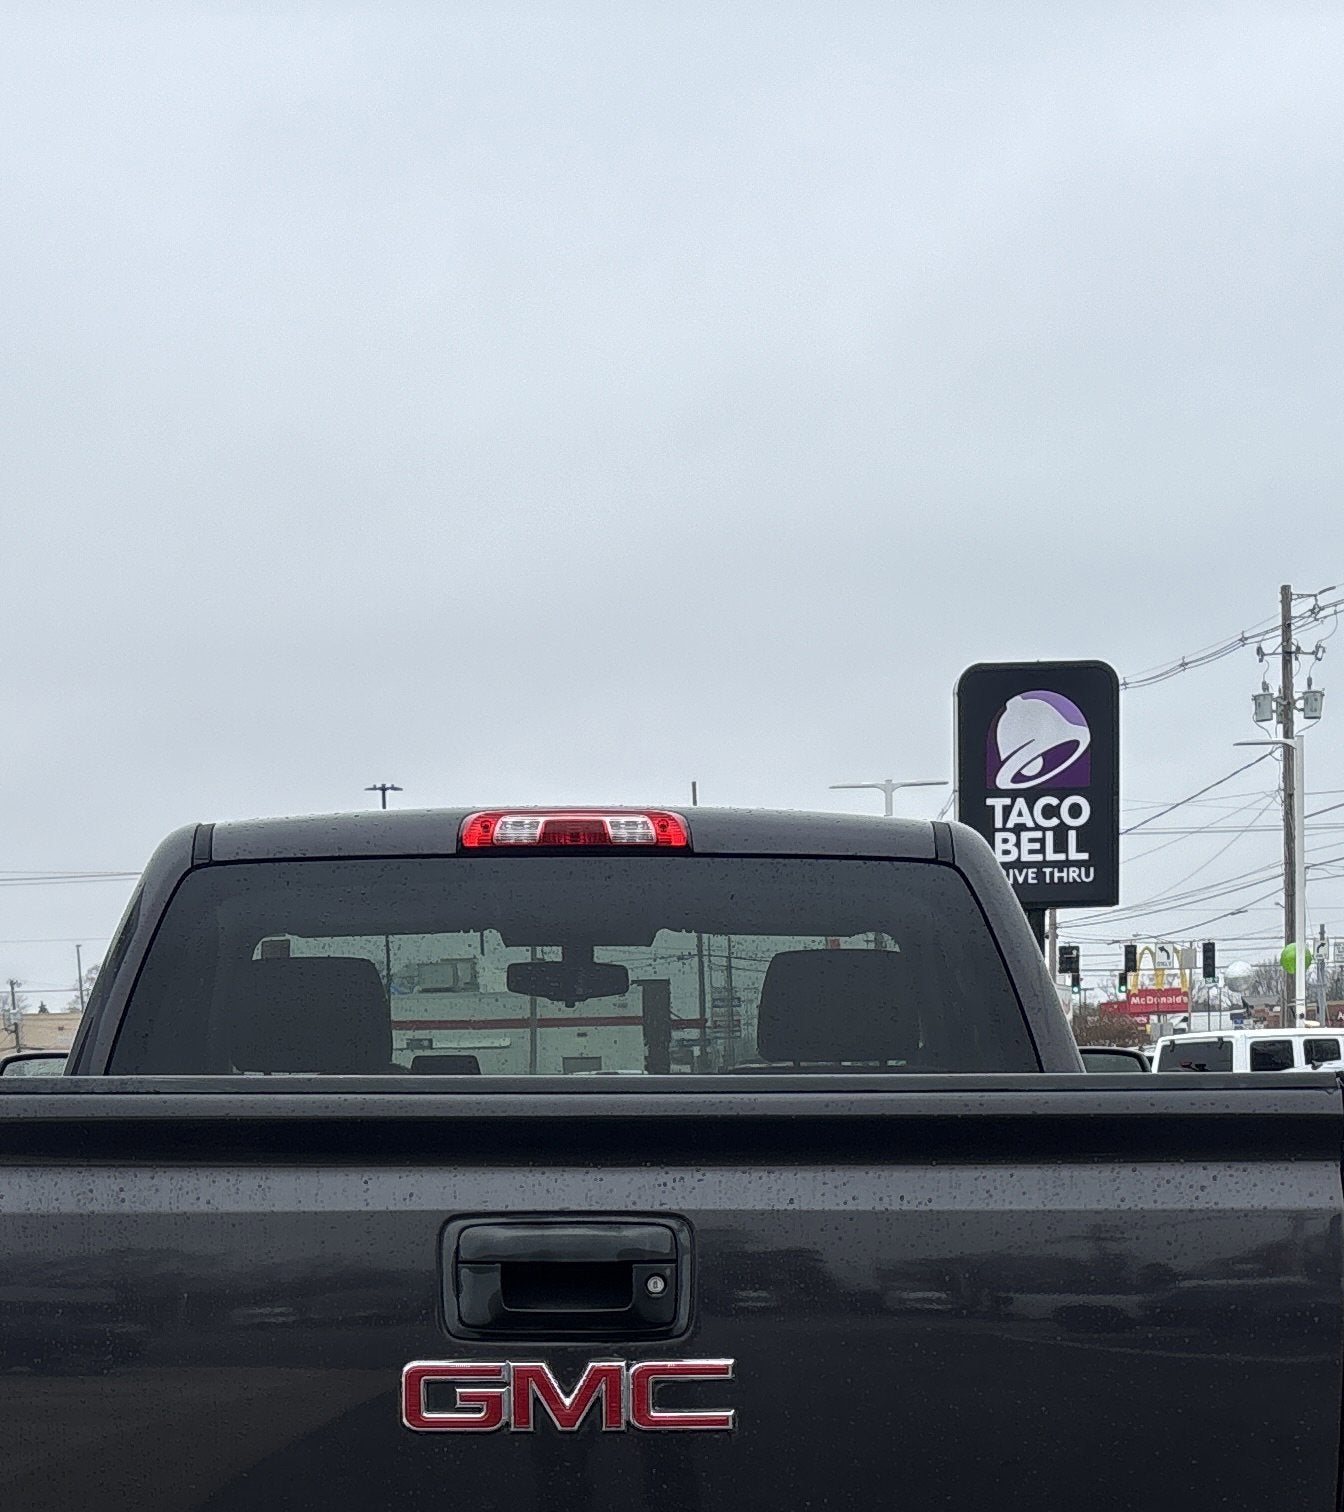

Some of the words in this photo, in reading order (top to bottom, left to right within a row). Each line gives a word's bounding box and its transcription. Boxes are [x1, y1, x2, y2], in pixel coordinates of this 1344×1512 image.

[985, 795, 1091, 830] TACO
[994, 830, 1089, 862] BELL
[1002, 868, 1038, 884] IVE
[1042, 866, 1095, 884] THRU
[1130, 995, 1188, 1005] McDonald's
[400, 1357, 738, 1434] GMC
